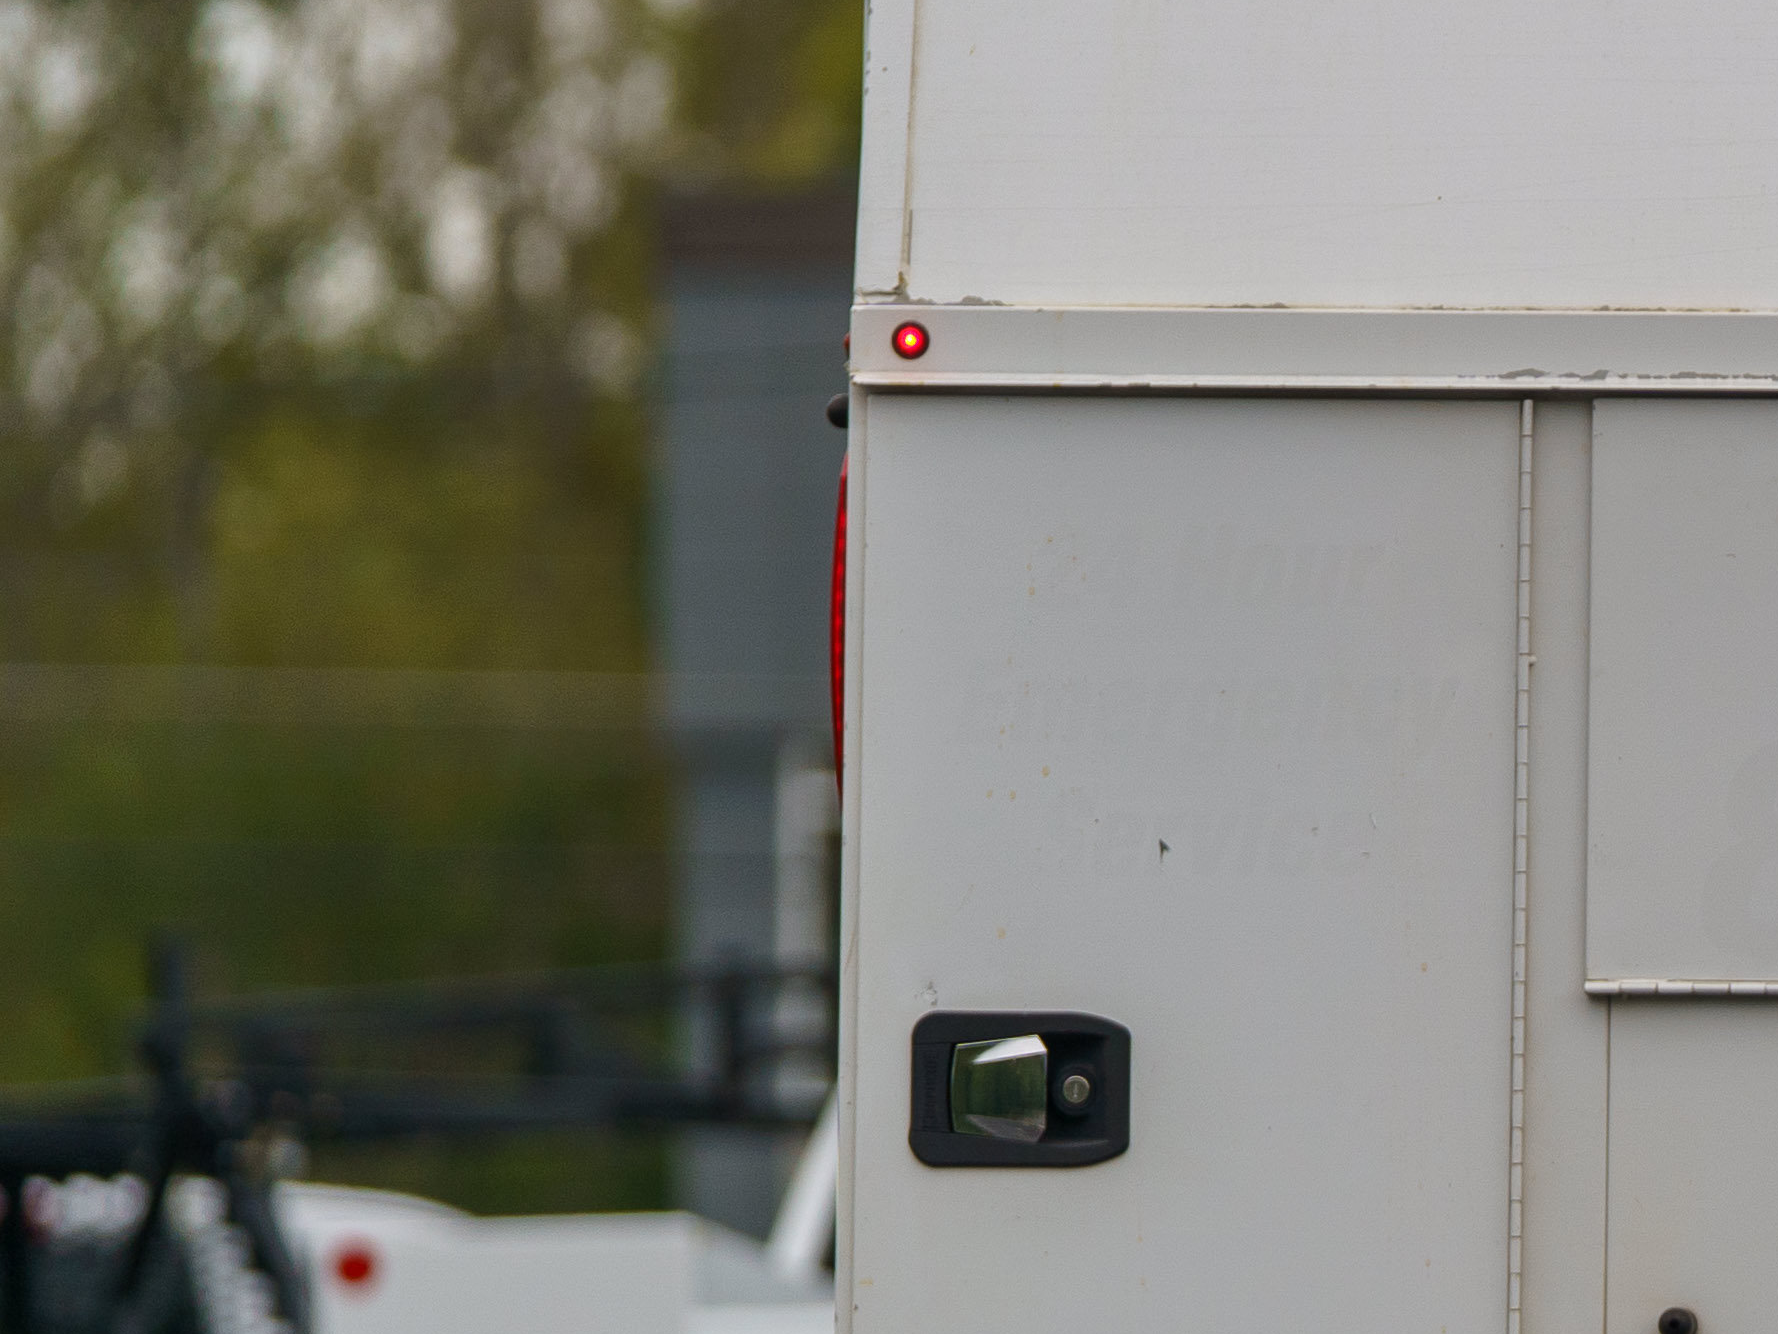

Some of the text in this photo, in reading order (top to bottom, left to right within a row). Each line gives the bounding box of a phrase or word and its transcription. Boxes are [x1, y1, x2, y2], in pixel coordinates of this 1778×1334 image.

[1170, 523, 1387, 611] Hour
[957, 655, 1460, 762] Emergency
[1042, 784, 1375, 876] Service
